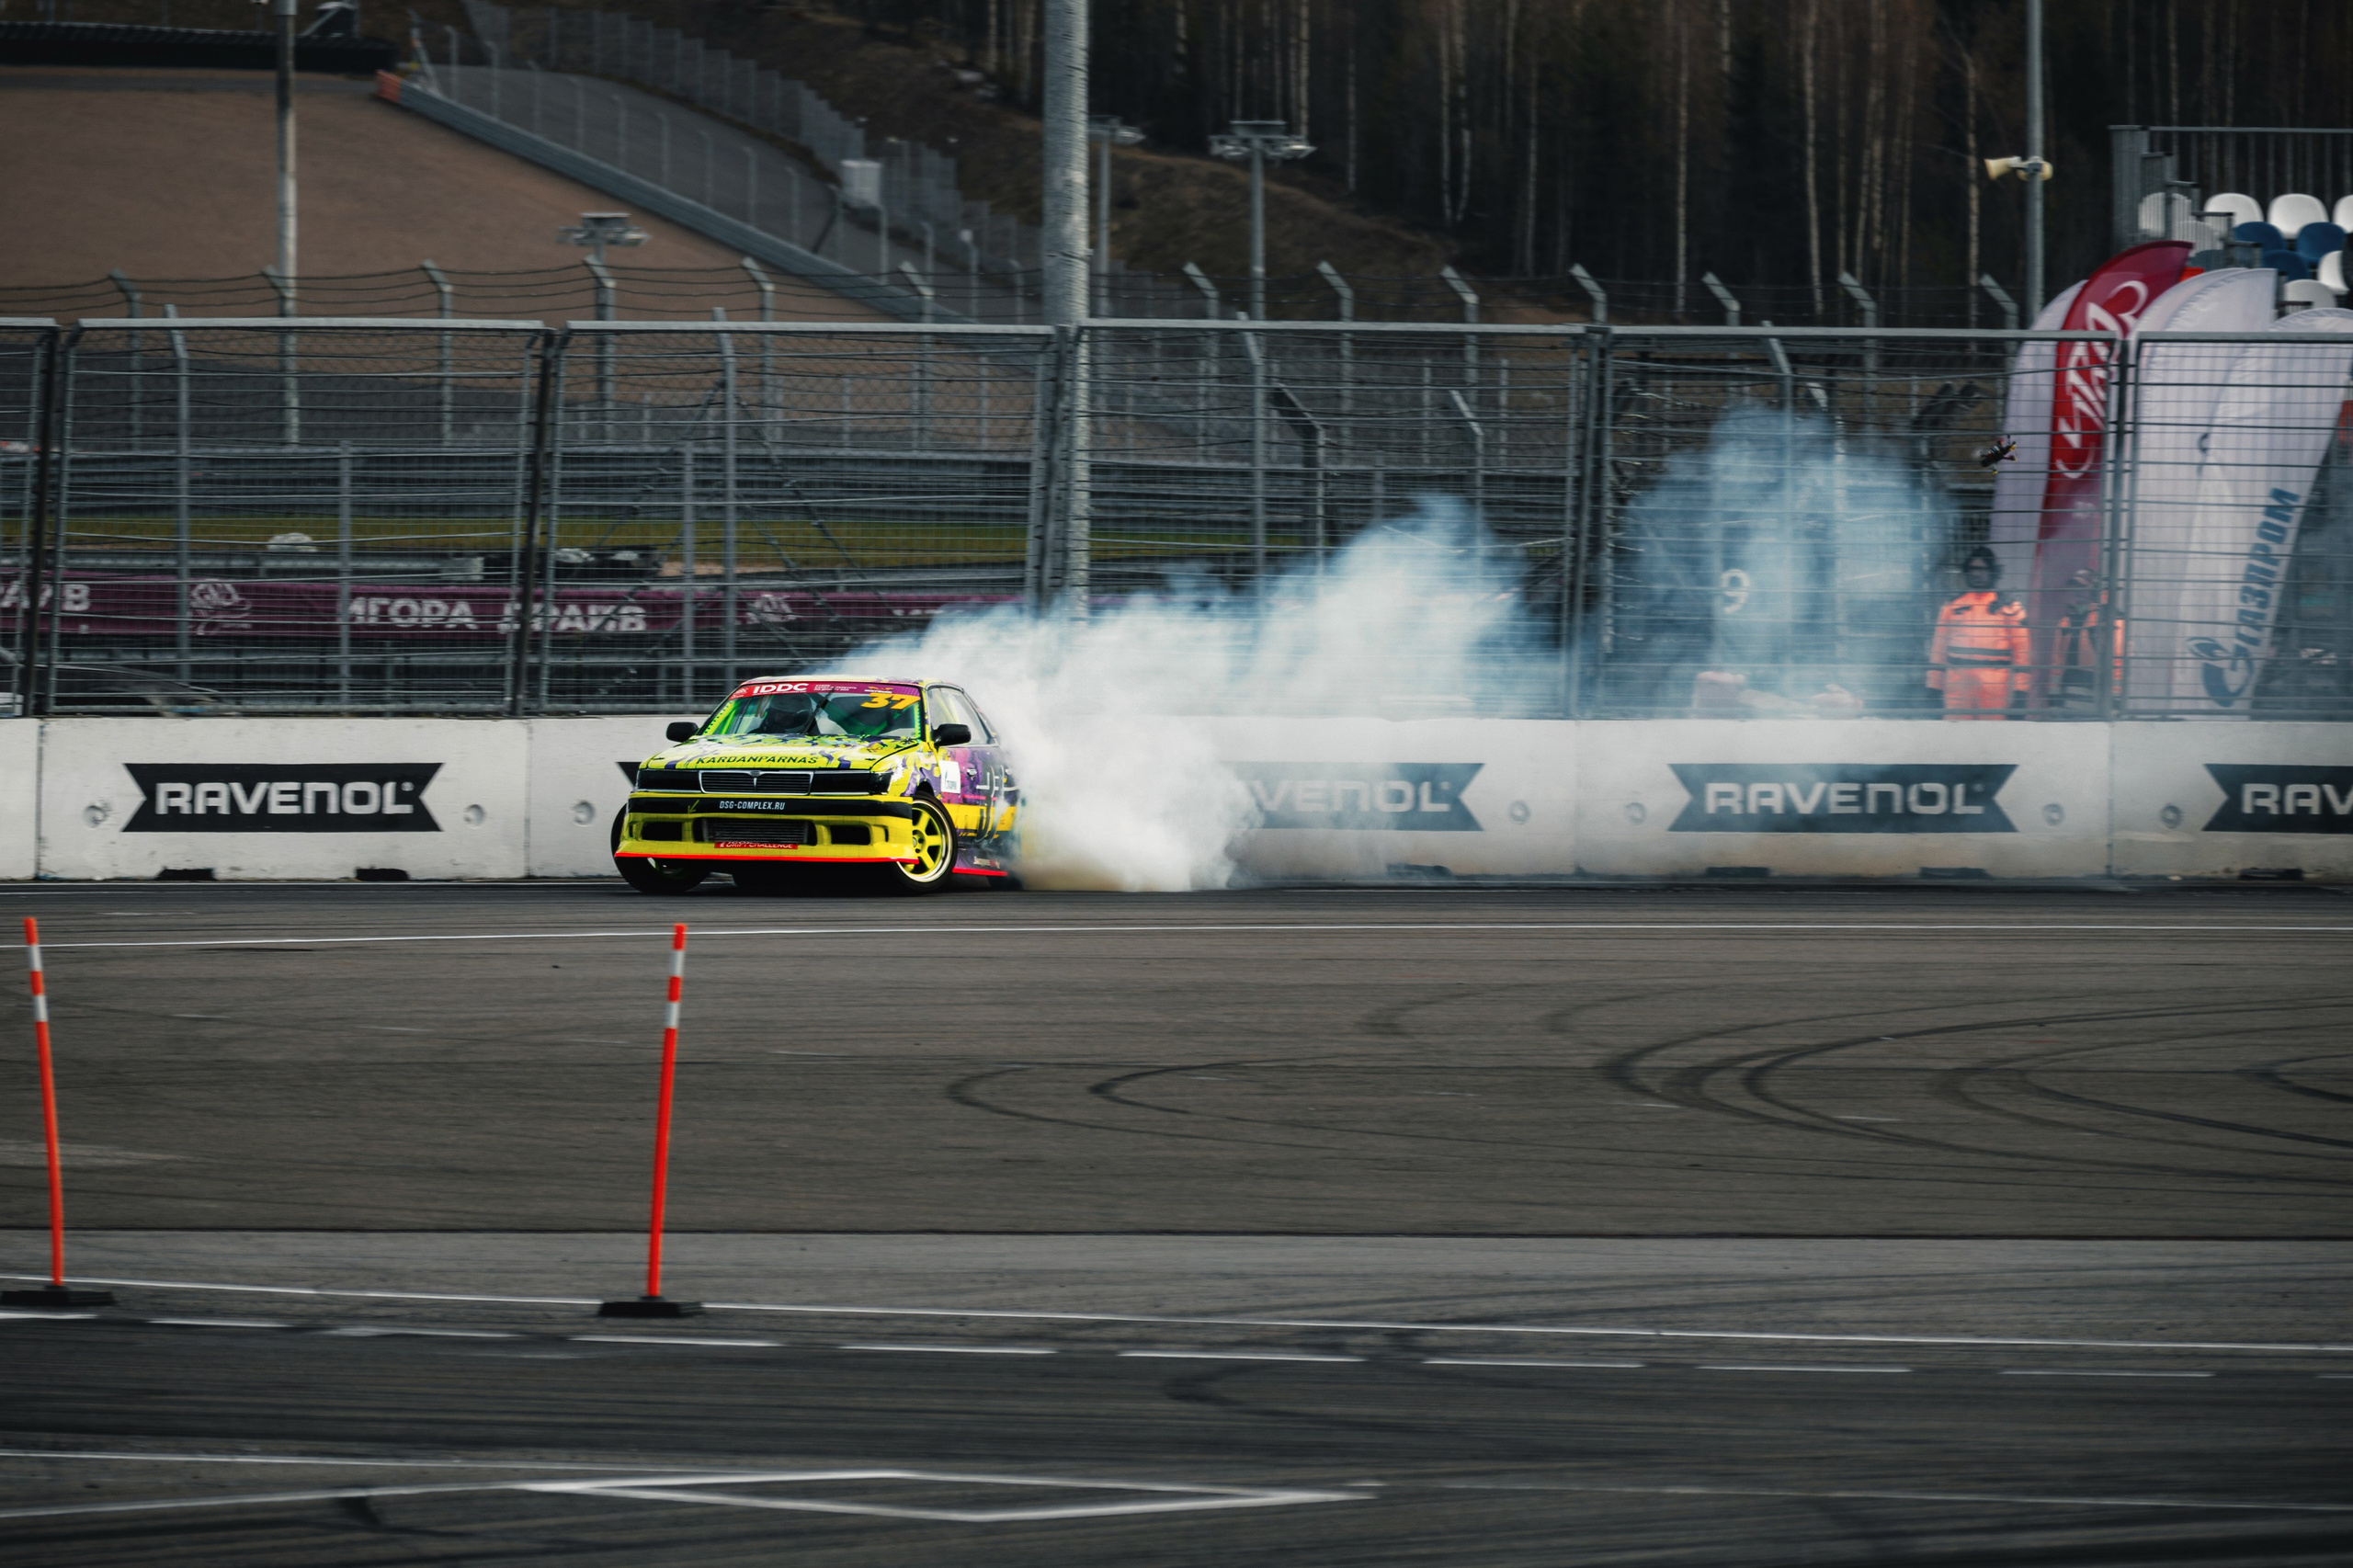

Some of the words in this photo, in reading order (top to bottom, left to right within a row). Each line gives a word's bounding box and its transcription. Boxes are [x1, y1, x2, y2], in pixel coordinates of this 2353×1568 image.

[1720, 568, 1751, 614] 9
[753, 683, 809, 694] IDDC
[860, 692, 921, 710] 37
[696, 756, 819, 765] KARDANPARNAS
[154, 781, 414, 814] RAVENOL
[719, 801, 786, 811] DSG-COMPLEX.RU
[1249, 779, 1452, 812] VENOL
[1704, 782, 1985, 814] RAVENOL
